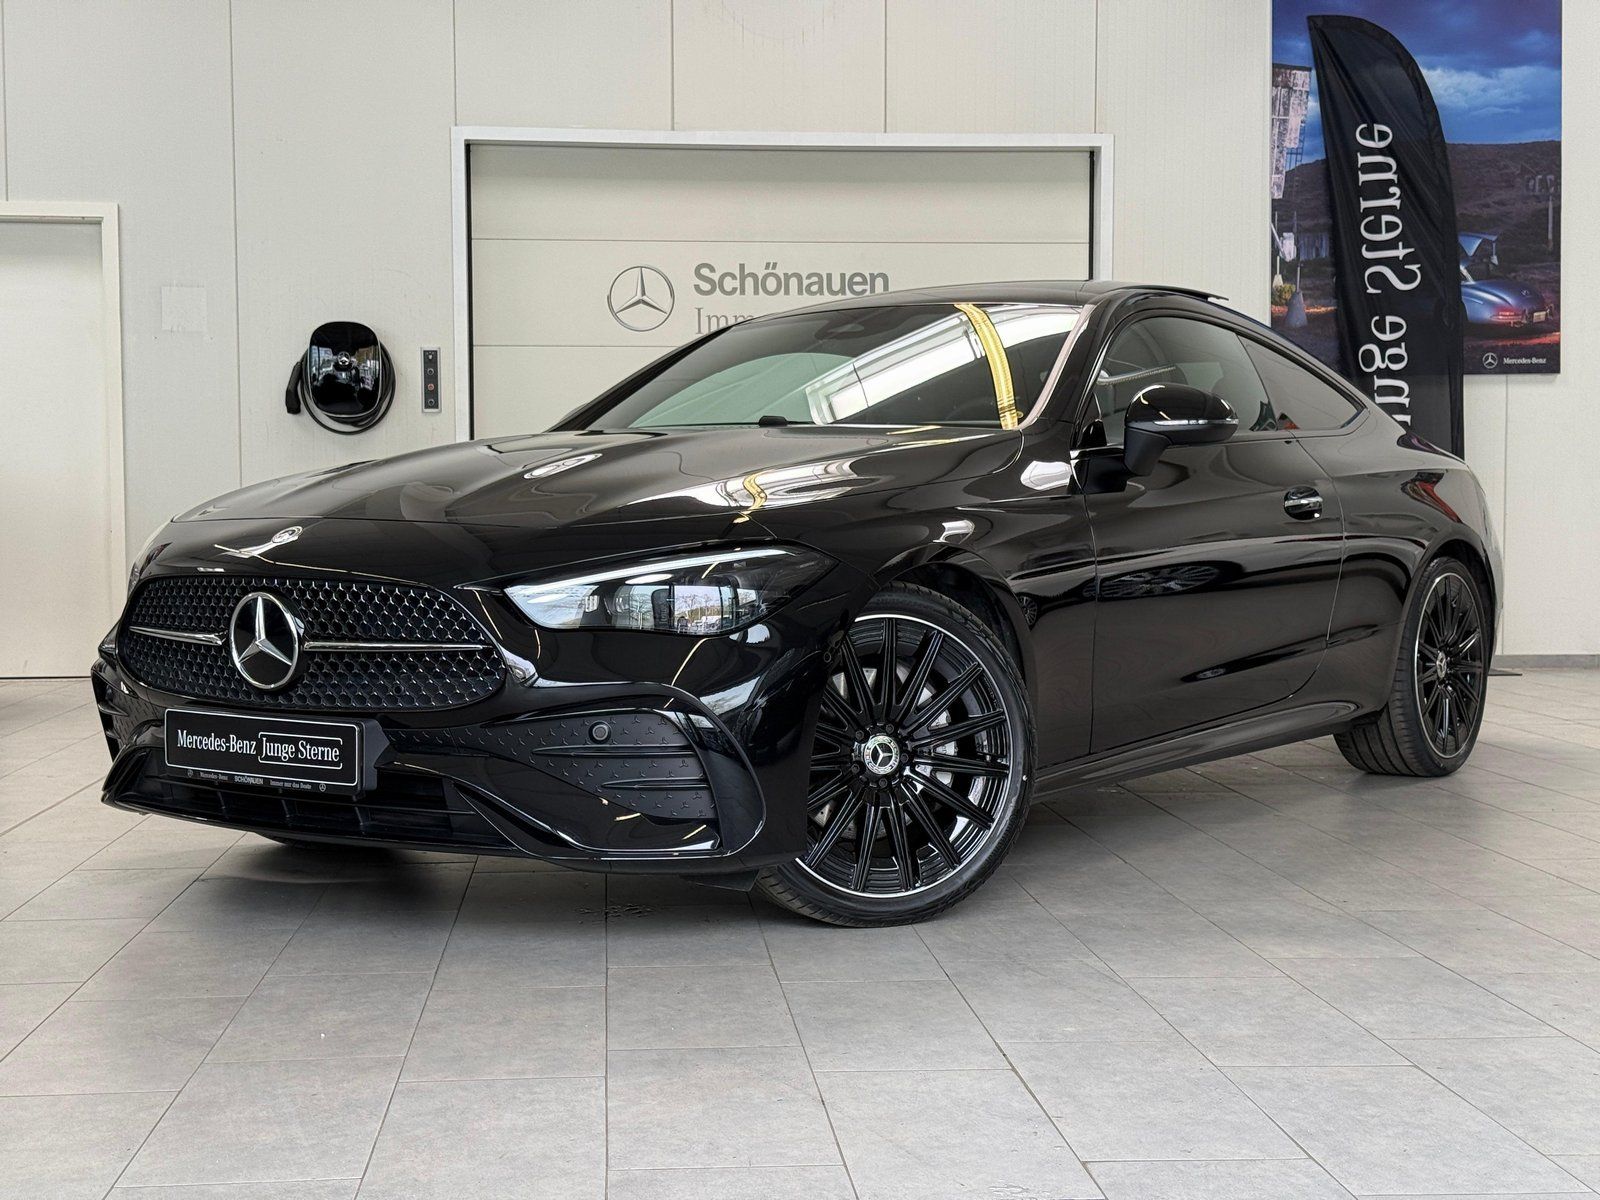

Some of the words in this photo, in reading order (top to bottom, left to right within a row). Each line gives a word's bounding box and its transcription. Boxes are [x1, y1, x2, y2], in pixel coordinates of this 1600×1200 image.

[693, 262, 890, 297] Schönauen
[1503, 356, 1547, 366] Mercedes-Benz
[177, 729, 257, 755] Mercedes-Benz
[261, 737, 296, 761] Junge
[298, 740, 340, 762] Sterne
